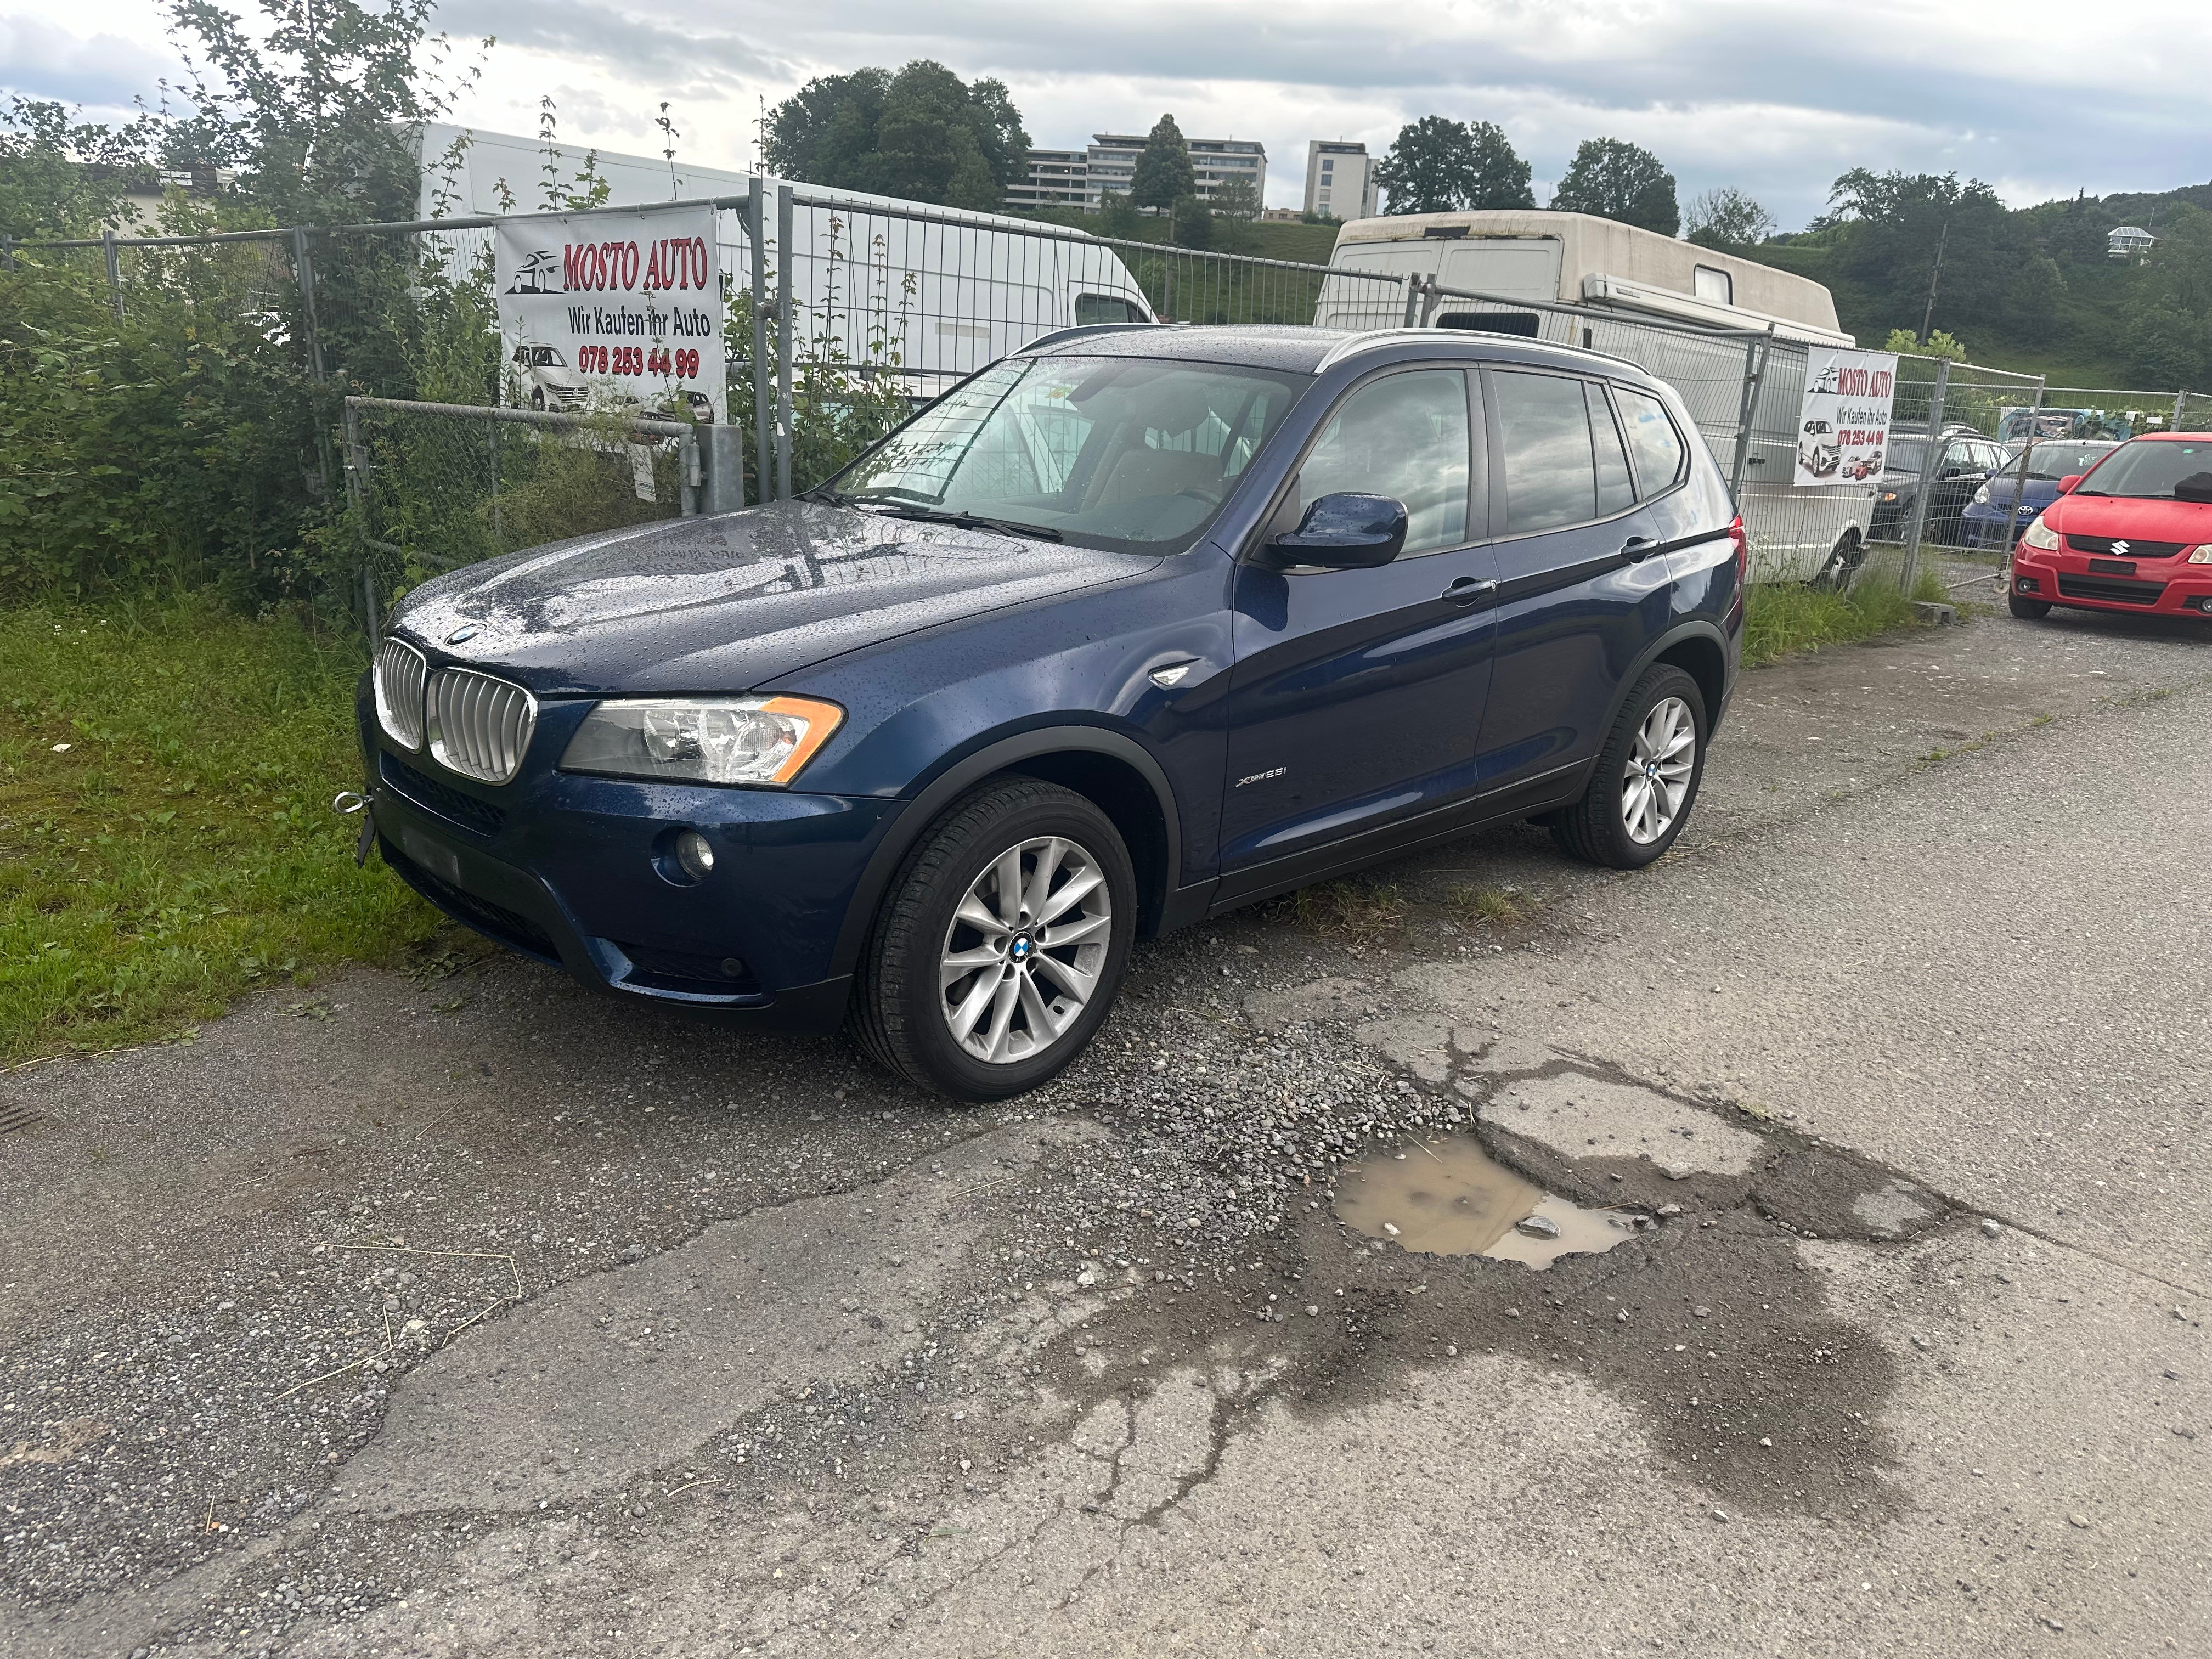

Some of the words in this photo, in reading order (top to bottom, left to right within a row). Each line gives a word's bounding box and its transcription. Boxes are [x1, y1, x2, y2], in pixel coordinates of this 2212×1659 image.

[563, 240, 639, 291] MOSTO
[643, 236, 708, 291] AUTO
[567, 305, 591, 334] Wir
[594, 305, 644, 335] Kaufen
[647, 306, 668, 336] ihr
[673, 307, 710, 337] Auto
[579, 345, 608, 375] 078
[612, 346, 644, 376] 253
[647, 348, 672, 378] 44
[675, 348, 699, 379] 99
[1836, 367, 1868, 397] MOSTO
[1868, 370, 1892, 398] AUTO
[1837, 406, 1847, 424] Wir
[1847, 407, 1866, 425] Kaufen
[1867, 407, 1875, 425] ihr
[1875, 408, 1887, 425] Auto
[1837, 430, 1851, 445] 078
[1851, 430, 1865, 446] 253
[1866, 430, 1875, 446] 44
